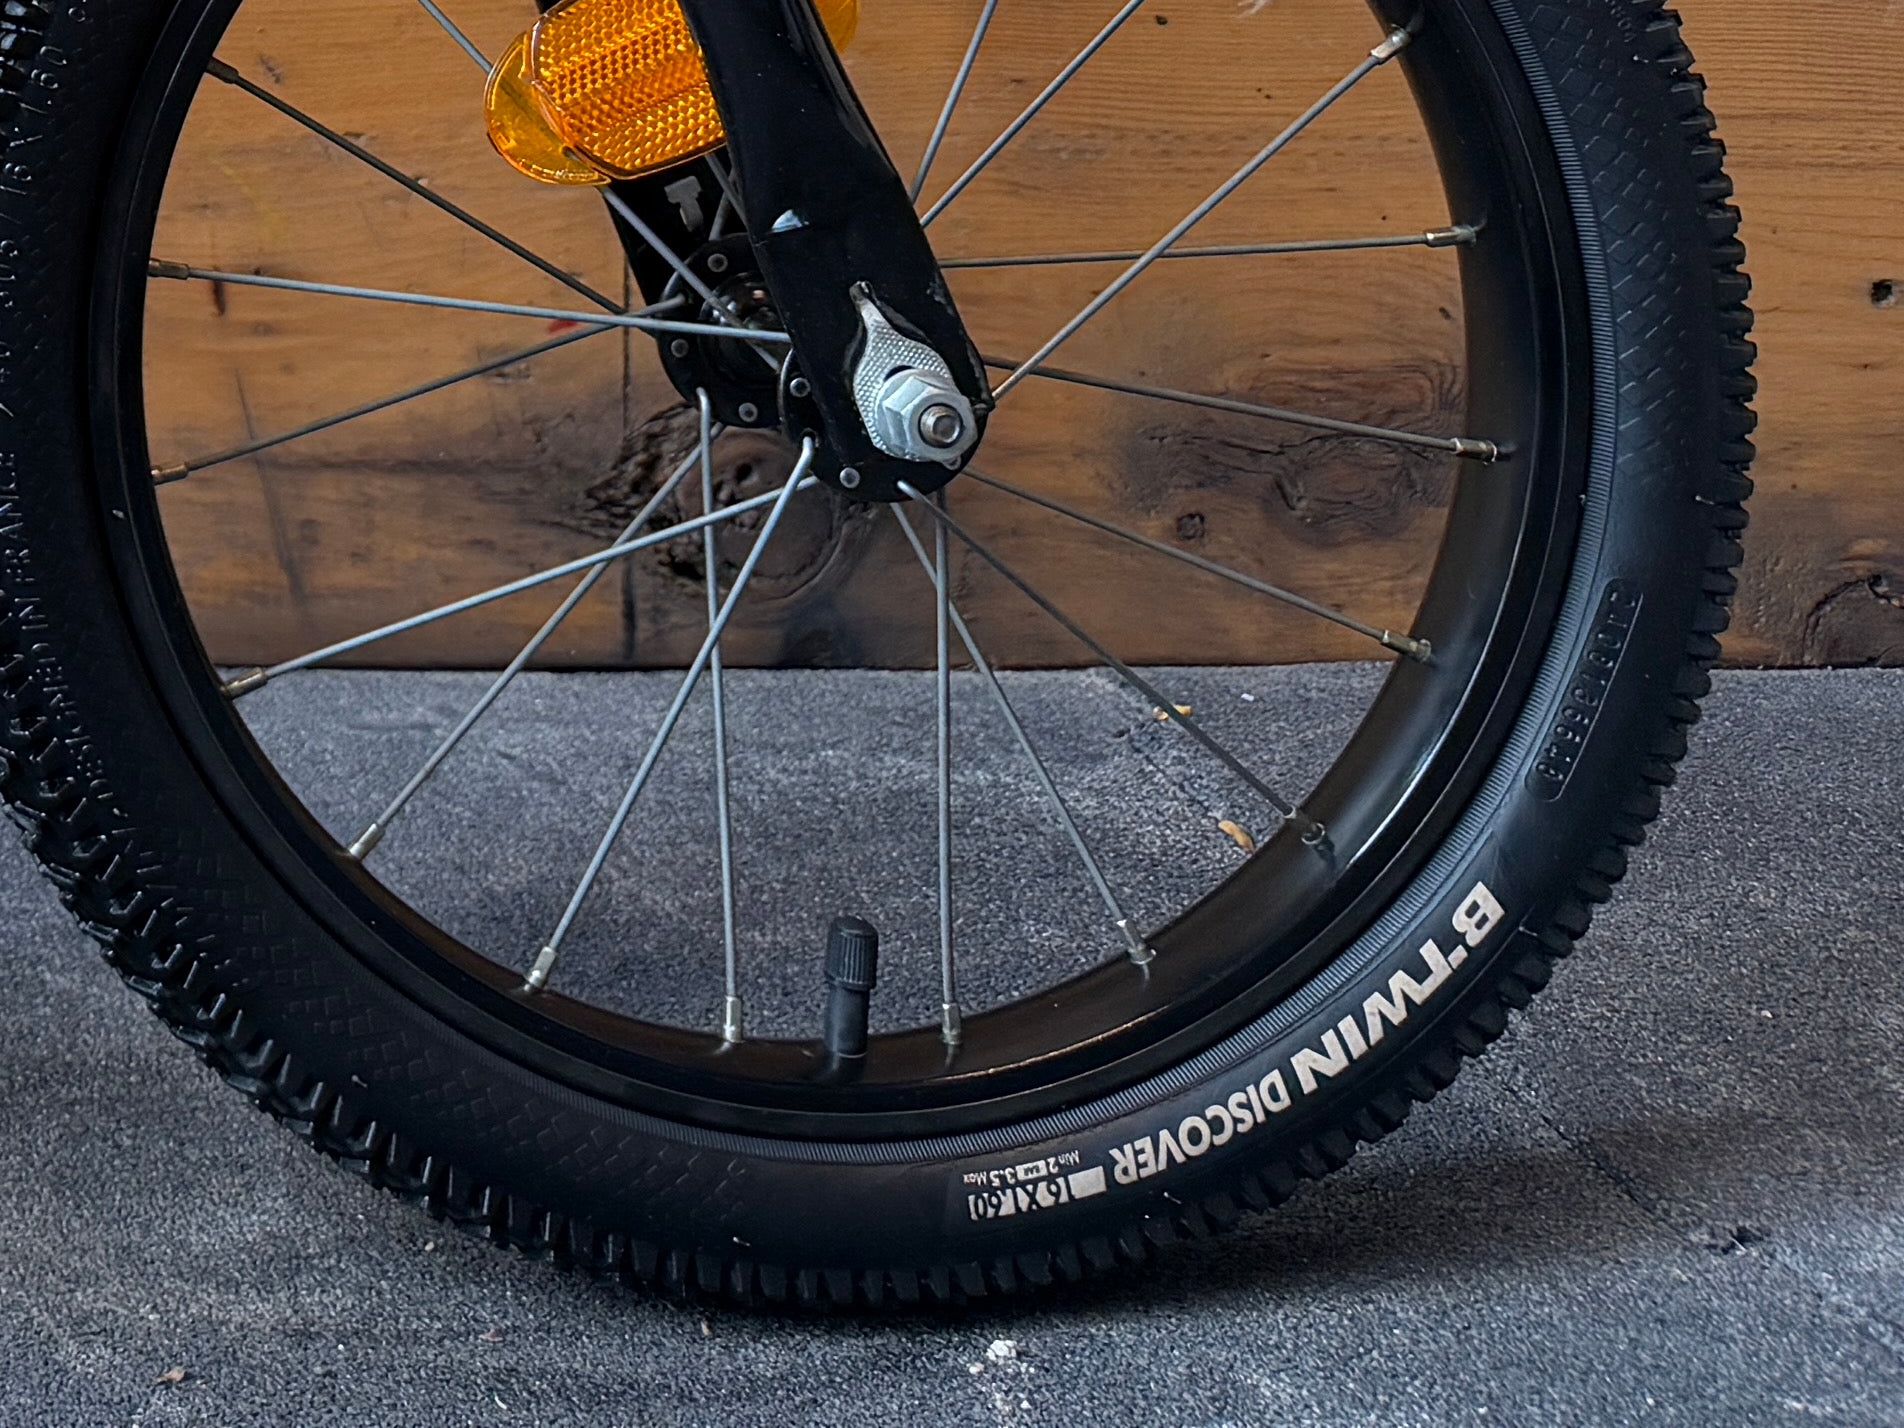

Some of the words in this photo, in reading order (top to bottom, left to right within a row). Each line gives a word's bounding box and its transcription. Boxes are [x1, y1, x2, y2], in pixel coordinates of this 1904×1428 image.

[13, 591, 49, 634] IN
[1108, 1076, 1288, 1185] DISCOVER
[1047, 1157, 1058, 1174] 2
[1058, 1149, 1080, 1167] Min
[962, 1171, 987, 1186] Max
[989, 1167, 1015, 1186] 3.5
